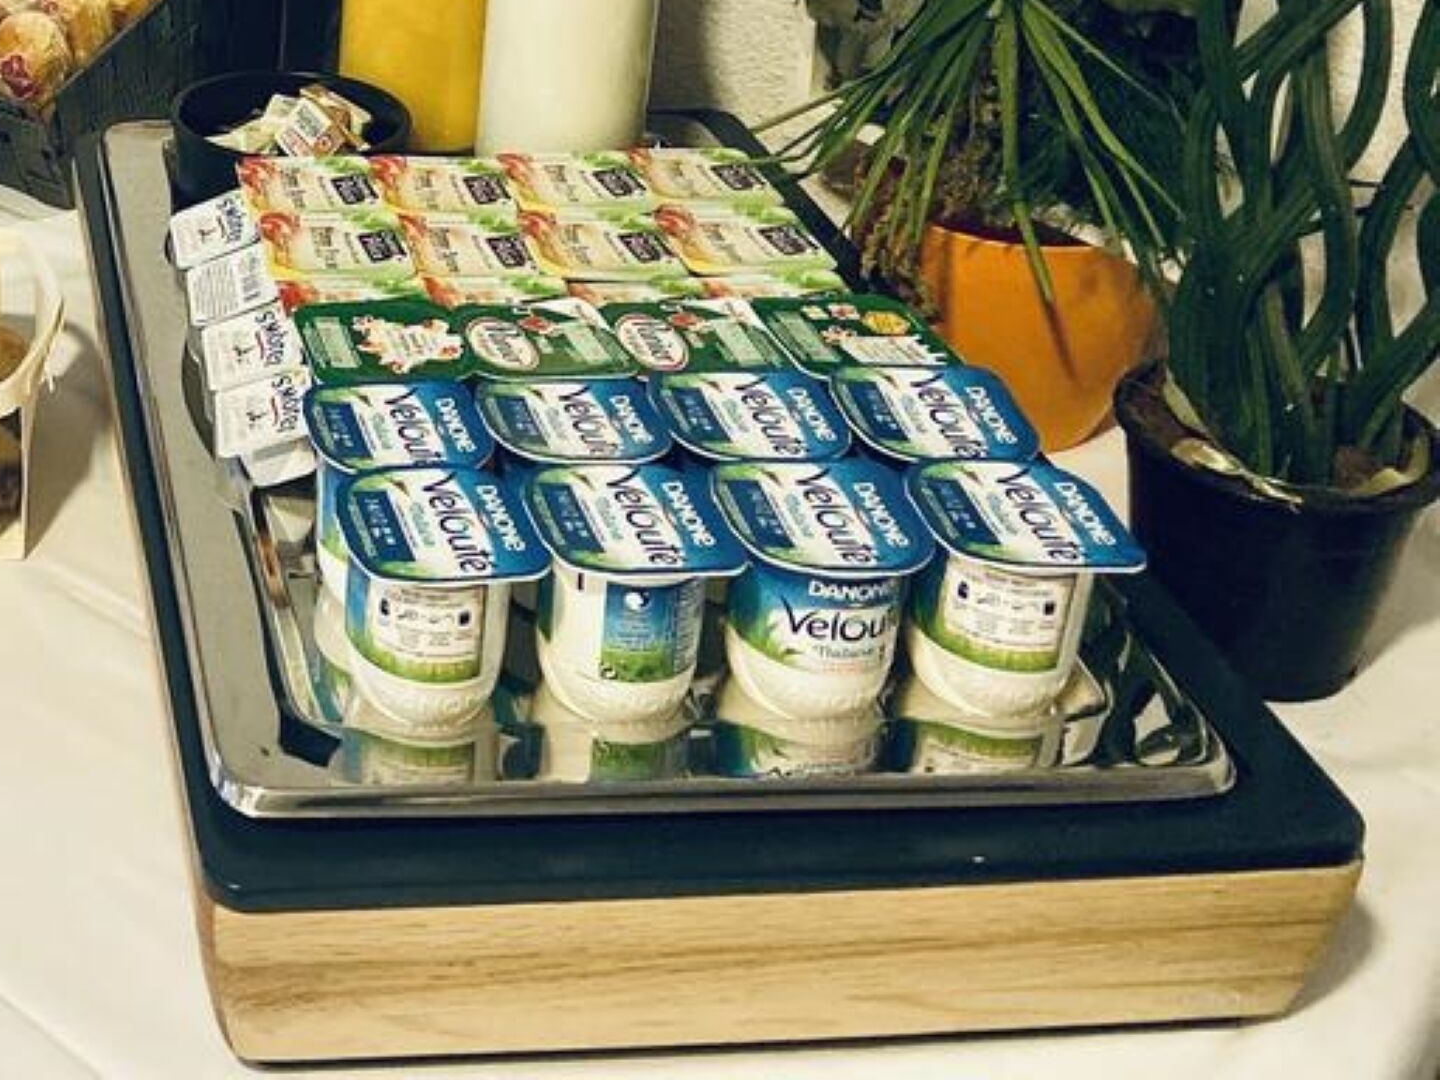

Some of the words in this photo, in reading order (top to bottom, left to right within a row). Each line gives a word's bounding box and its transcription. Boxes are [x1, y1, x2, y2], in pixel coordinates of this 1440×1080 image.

[435, 397, 477, 454] DANONE
[965, 386, 1019, 445] DANONE
[422, 471, 496, 573] Velouté
[475, 484, 526, 552] DANONE
[605, 468, 687, 565] Velouté
[661, 481, 716, 547] DANONE
[795, 468, 879, 563] Velouté
[853, 481, 909, 548] DANONE
[996, 468, 1087, 563] Velouté
[1054, 481, 1117, 547] DANONE
